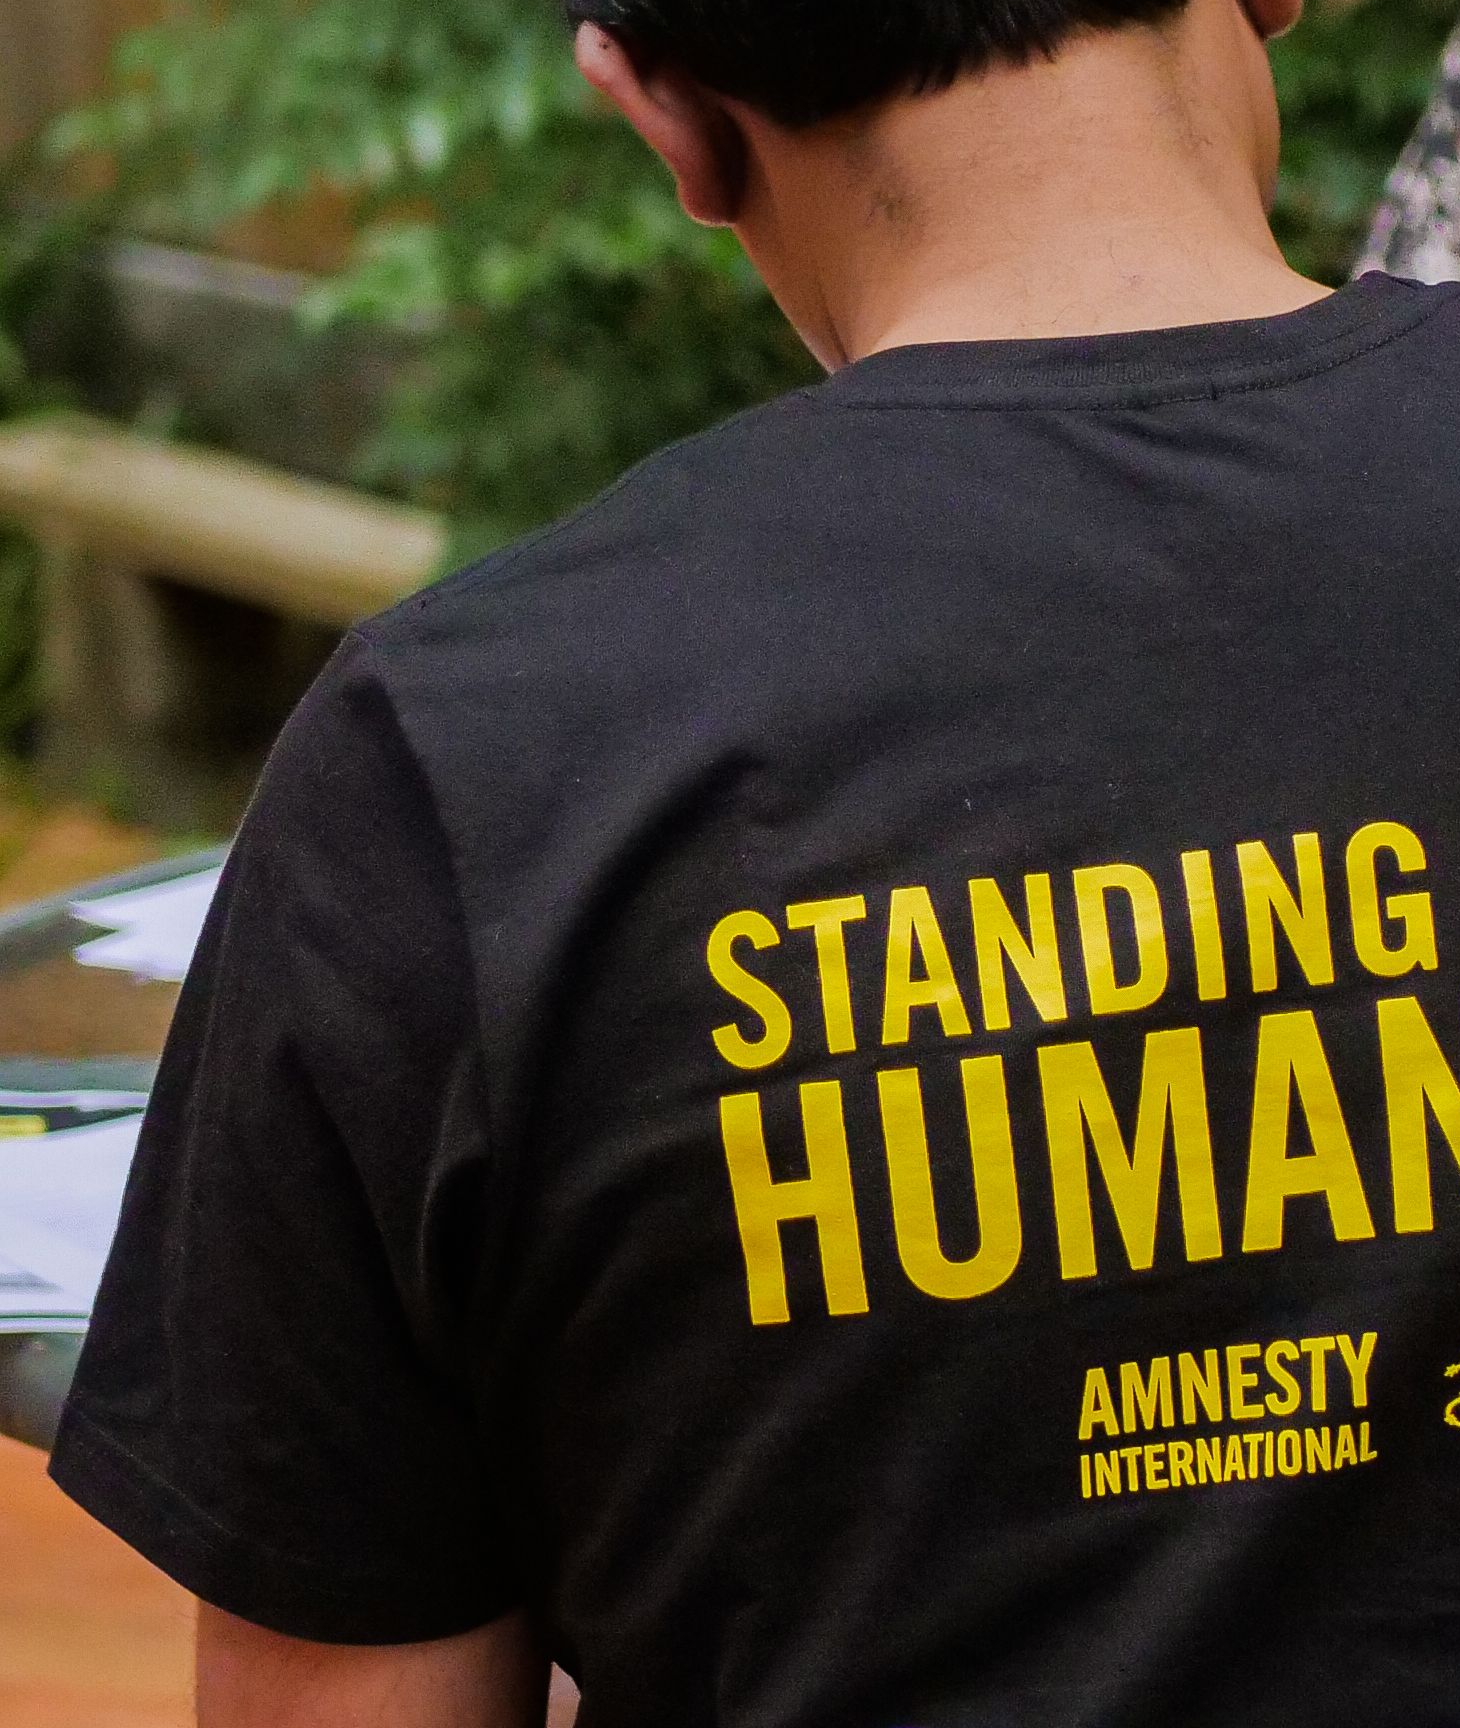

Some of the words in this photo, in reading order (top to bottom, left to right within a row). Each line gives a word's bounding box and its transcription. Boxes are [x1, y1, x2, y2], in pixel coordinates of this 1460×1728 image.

[705, 820, 1439, 1071] STANDING
[1079, 1331, 1378, 1441] AMNESTY
[1080, 1421, 1378, 1499] INTERNATIONAL
